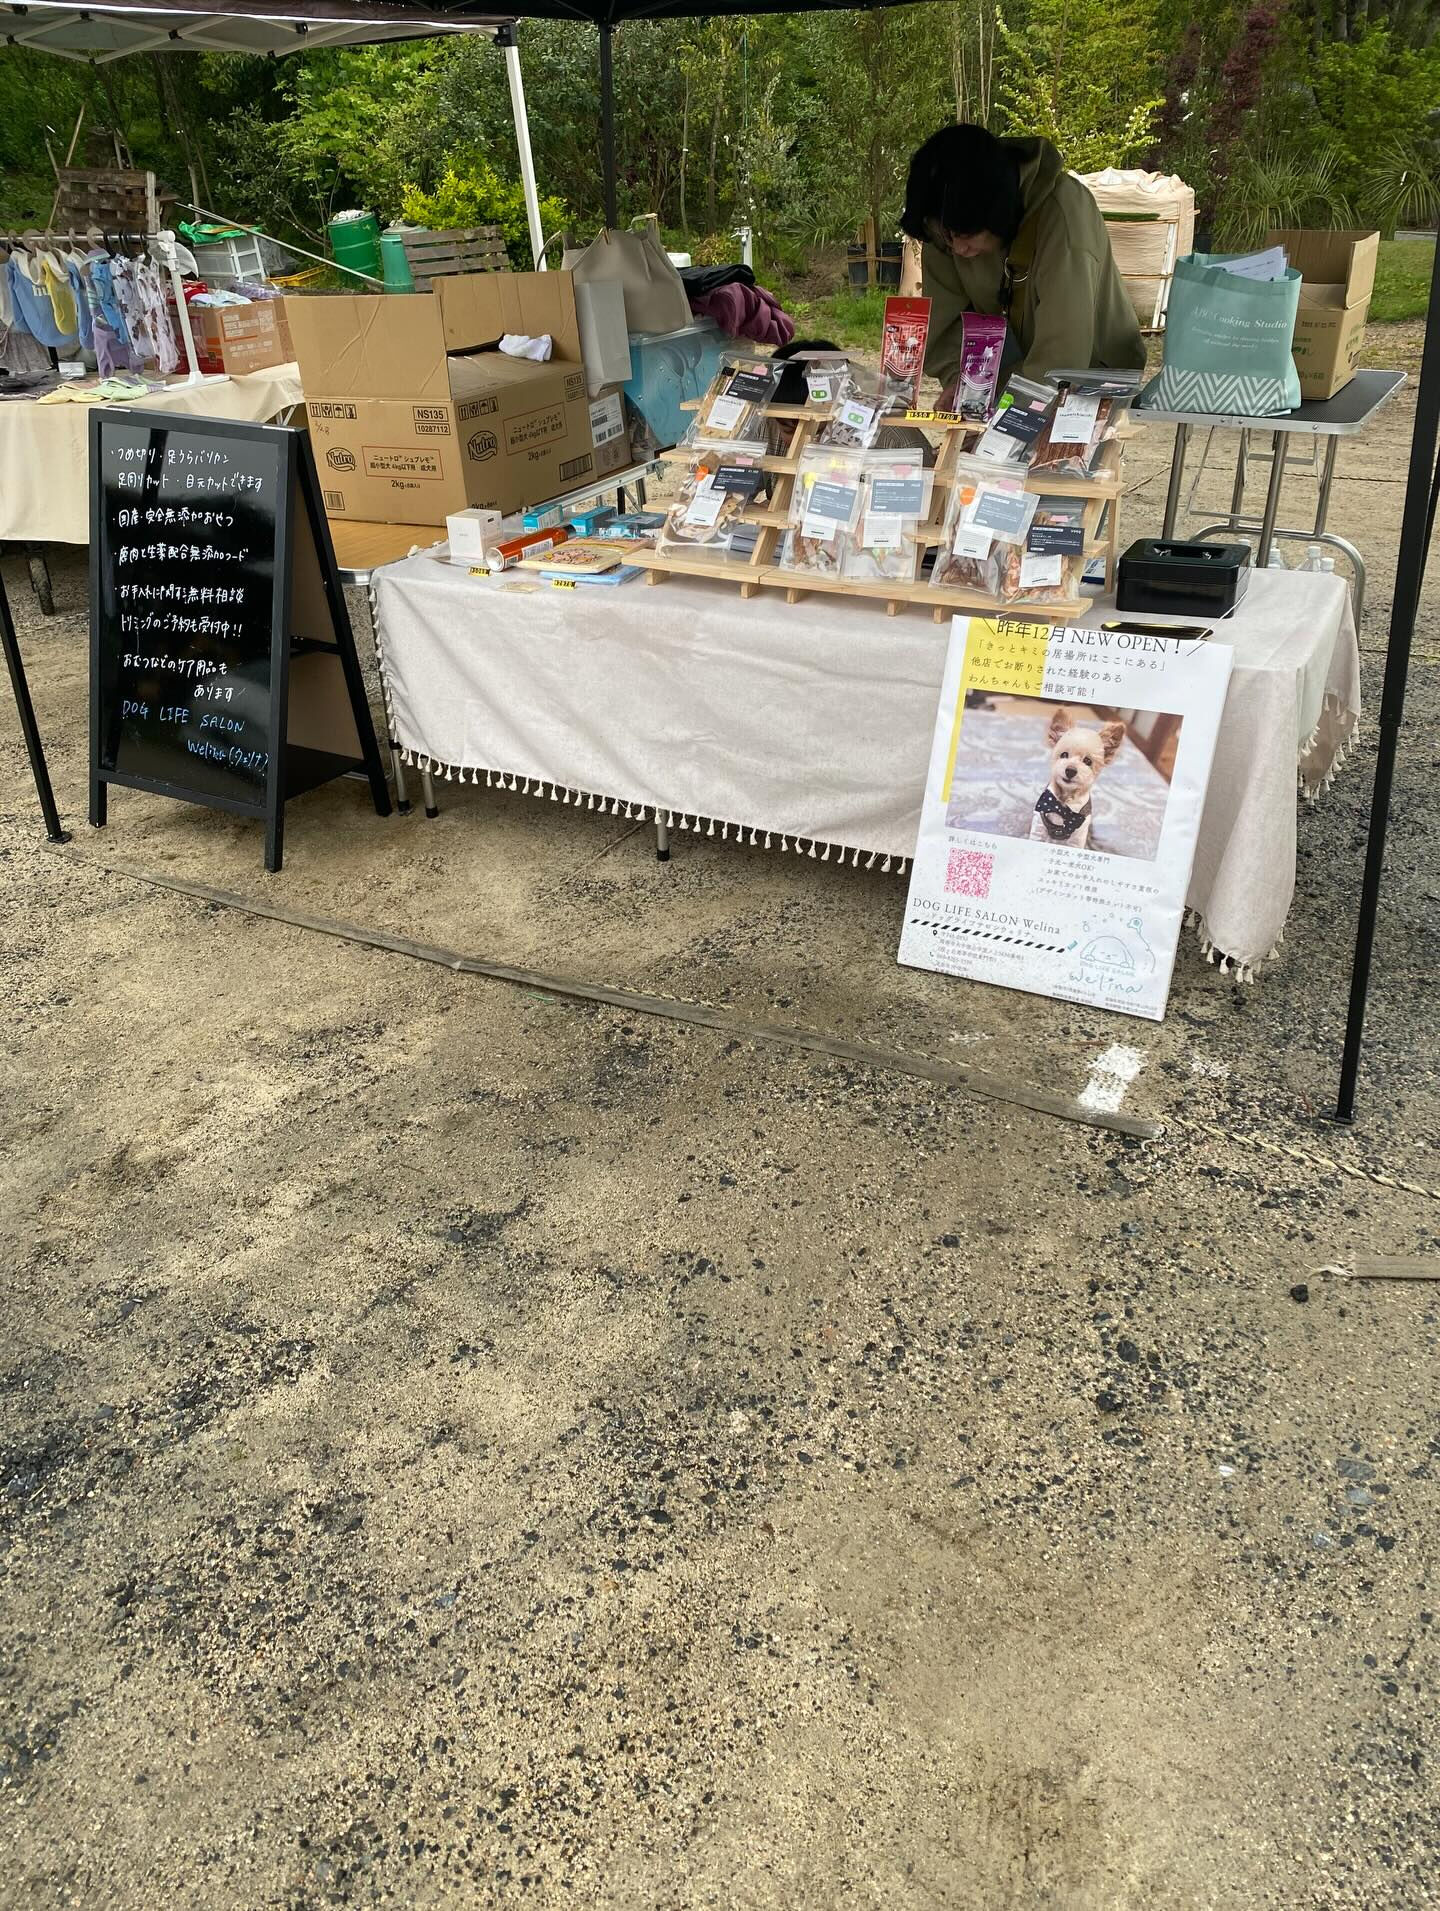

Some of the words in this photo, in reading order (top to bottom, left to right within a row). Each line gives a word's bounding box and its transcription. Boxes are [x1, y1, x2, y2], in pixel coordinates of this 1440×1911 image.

[1214, 312, 1250, 328] Cooking
[1254, 319, 1288, 329] Studio
[417, 409, 444, 419] NS135
[417, 425, 448, 433] 10287112
[996, 620, 1066, 643] 昨年12月
[1070, 628, 1114, 647] NEW
[971, 656, 1123, 684] 他店でお断りされた経験のある
[122, 700, 150, 719] DOG
[159, 706, 190, 724] LIFE
[200, 714, 245, 733] SALON
[913, 898, 940, 911] DOG
[945, 904, 971, 917] LIFE
[975, 909, 1019, 926] SALON
[1023, 918, 1061, 935] Welina
[1069, 968, 1143, 993] Welina
